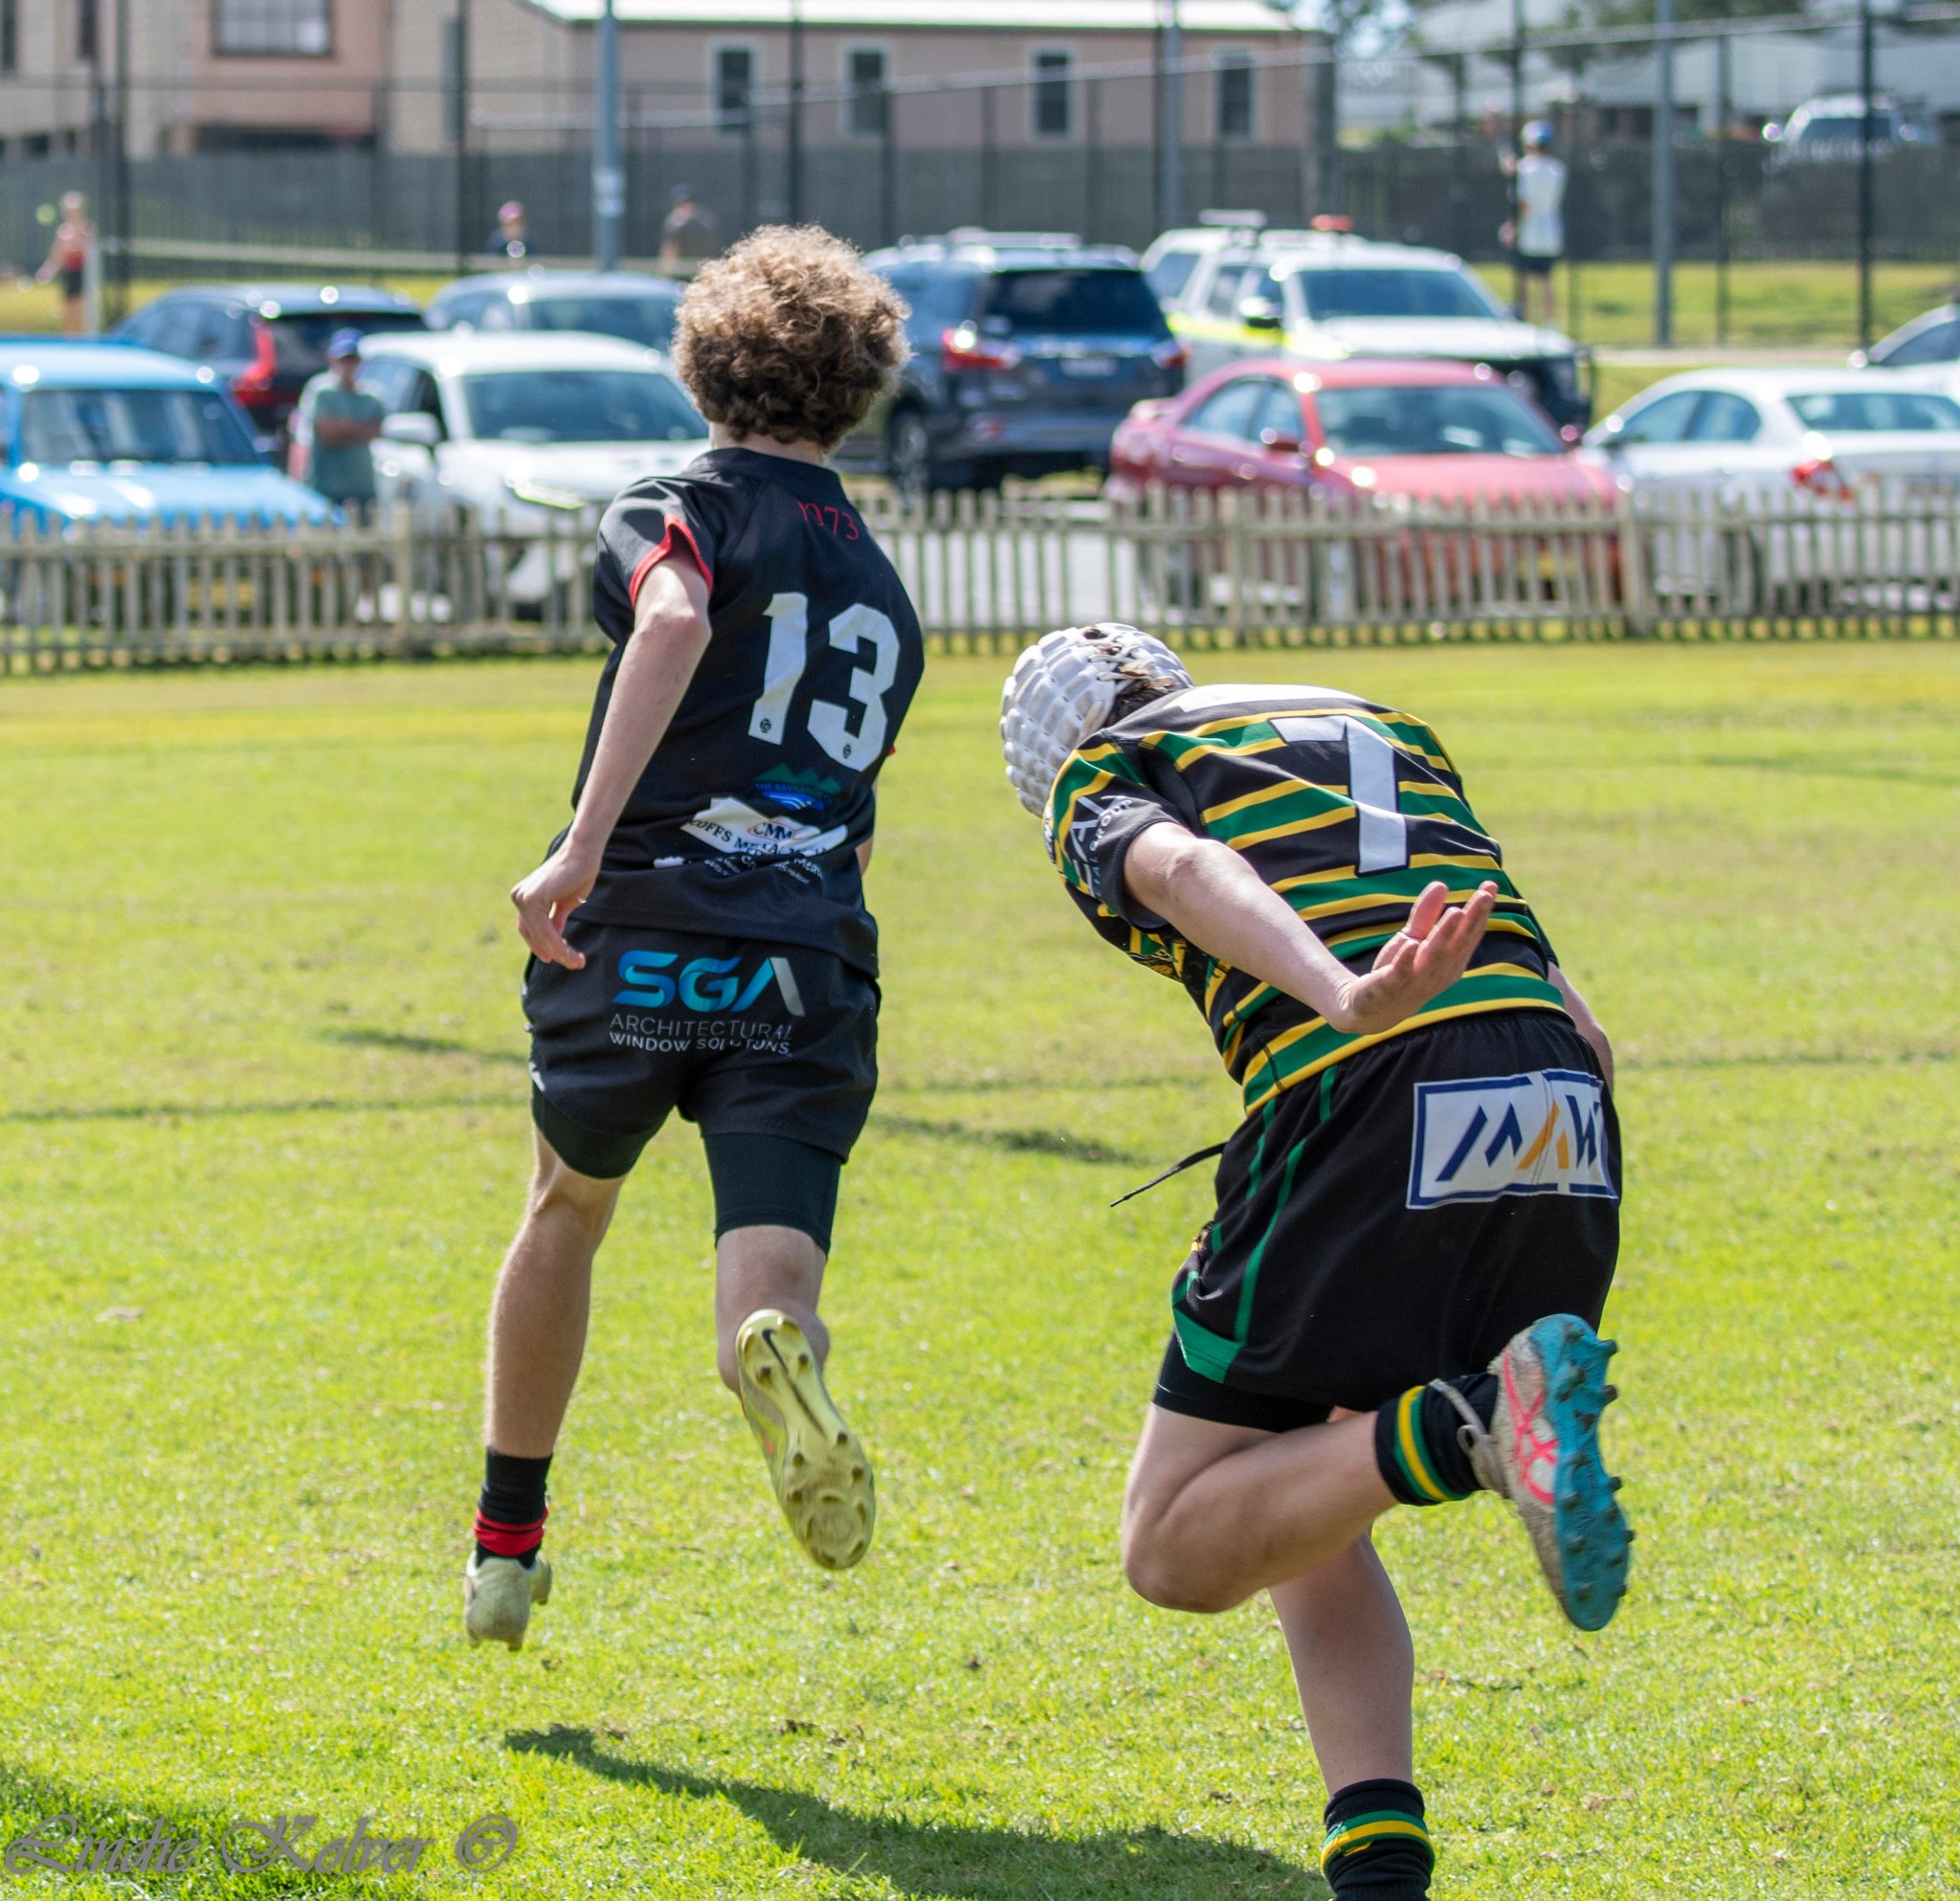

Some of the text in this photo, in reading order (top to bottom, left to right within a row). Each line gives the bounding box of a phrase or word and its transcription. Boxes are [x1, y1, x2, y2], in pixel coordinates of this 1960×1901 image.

[747, 591, 901, 772] 13
[612, 950, 806, 1018] SGA
[609, 1012, 793, 1040] ARCHITECTURAL
[609, 1031, 691, 1053] WINDOW
